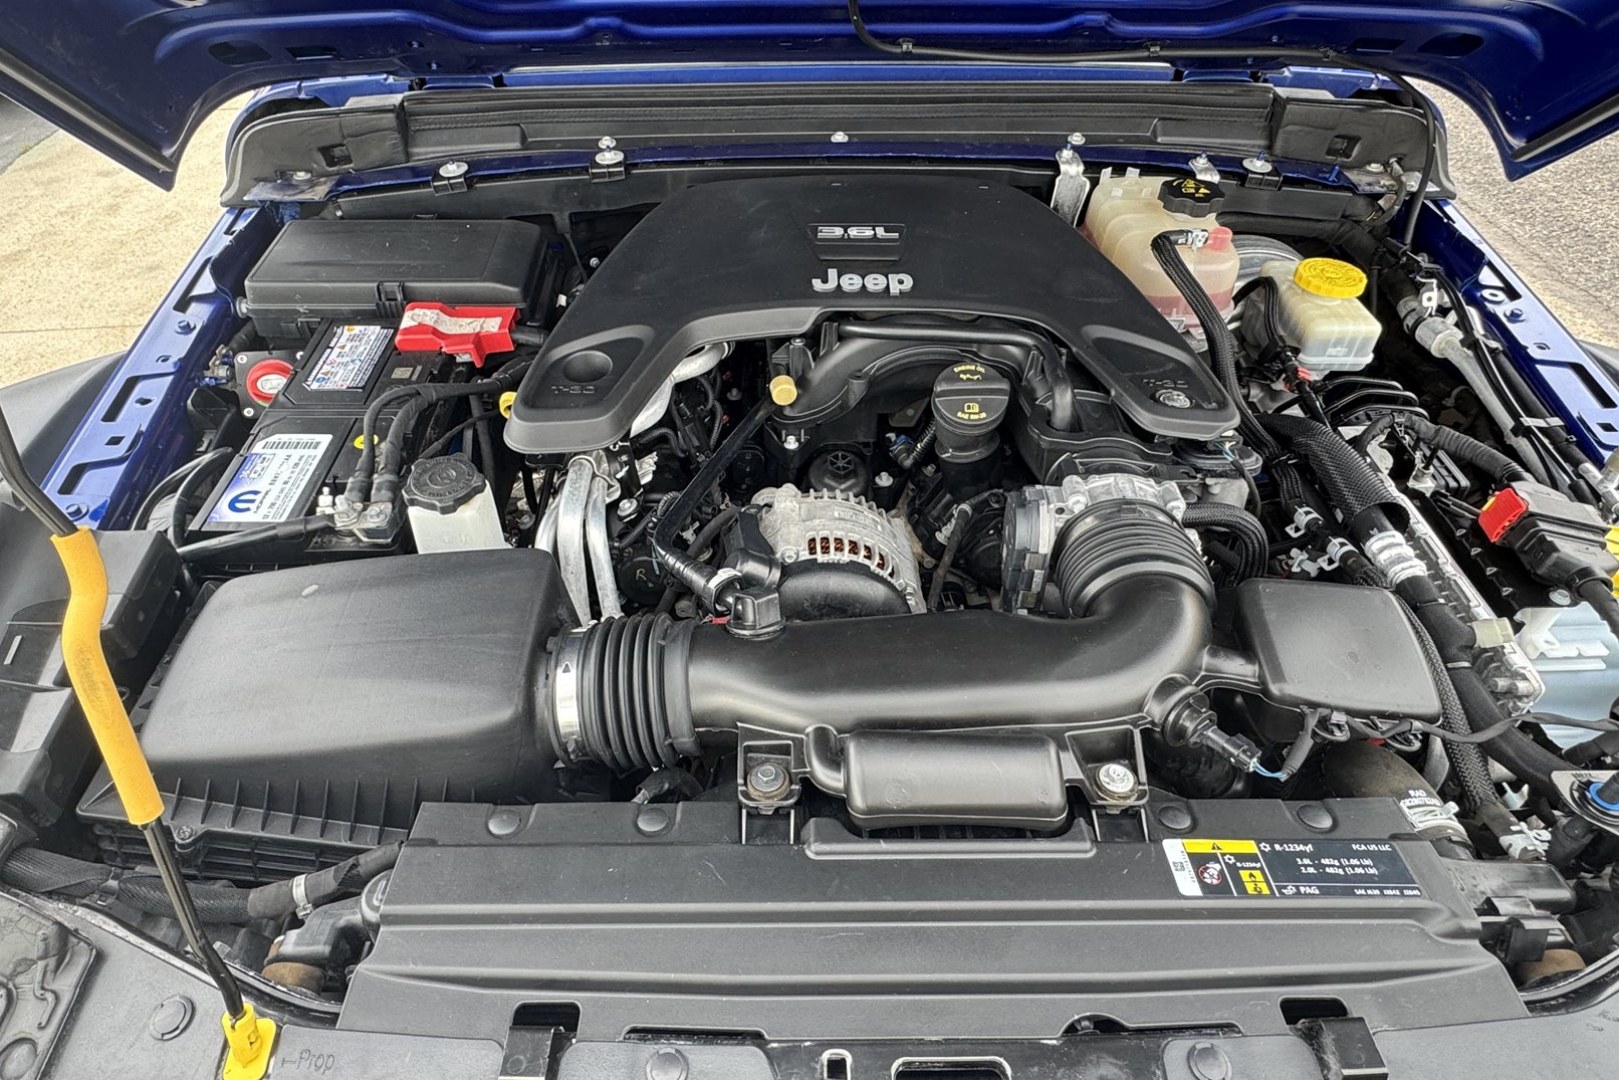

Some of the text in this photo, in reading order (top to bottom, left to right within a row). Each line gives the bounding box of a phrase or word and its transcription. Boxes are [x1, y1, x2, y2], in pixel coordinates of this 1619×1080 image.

[817, 226, 900, 239] 3.6L
[811, 268, 914, 296] Jeep
[1274, 843, 1314, 853] R-1234yf
[1299, 886, 1320, 895] PAG
[296, 1048, 336, 1076] Prop
